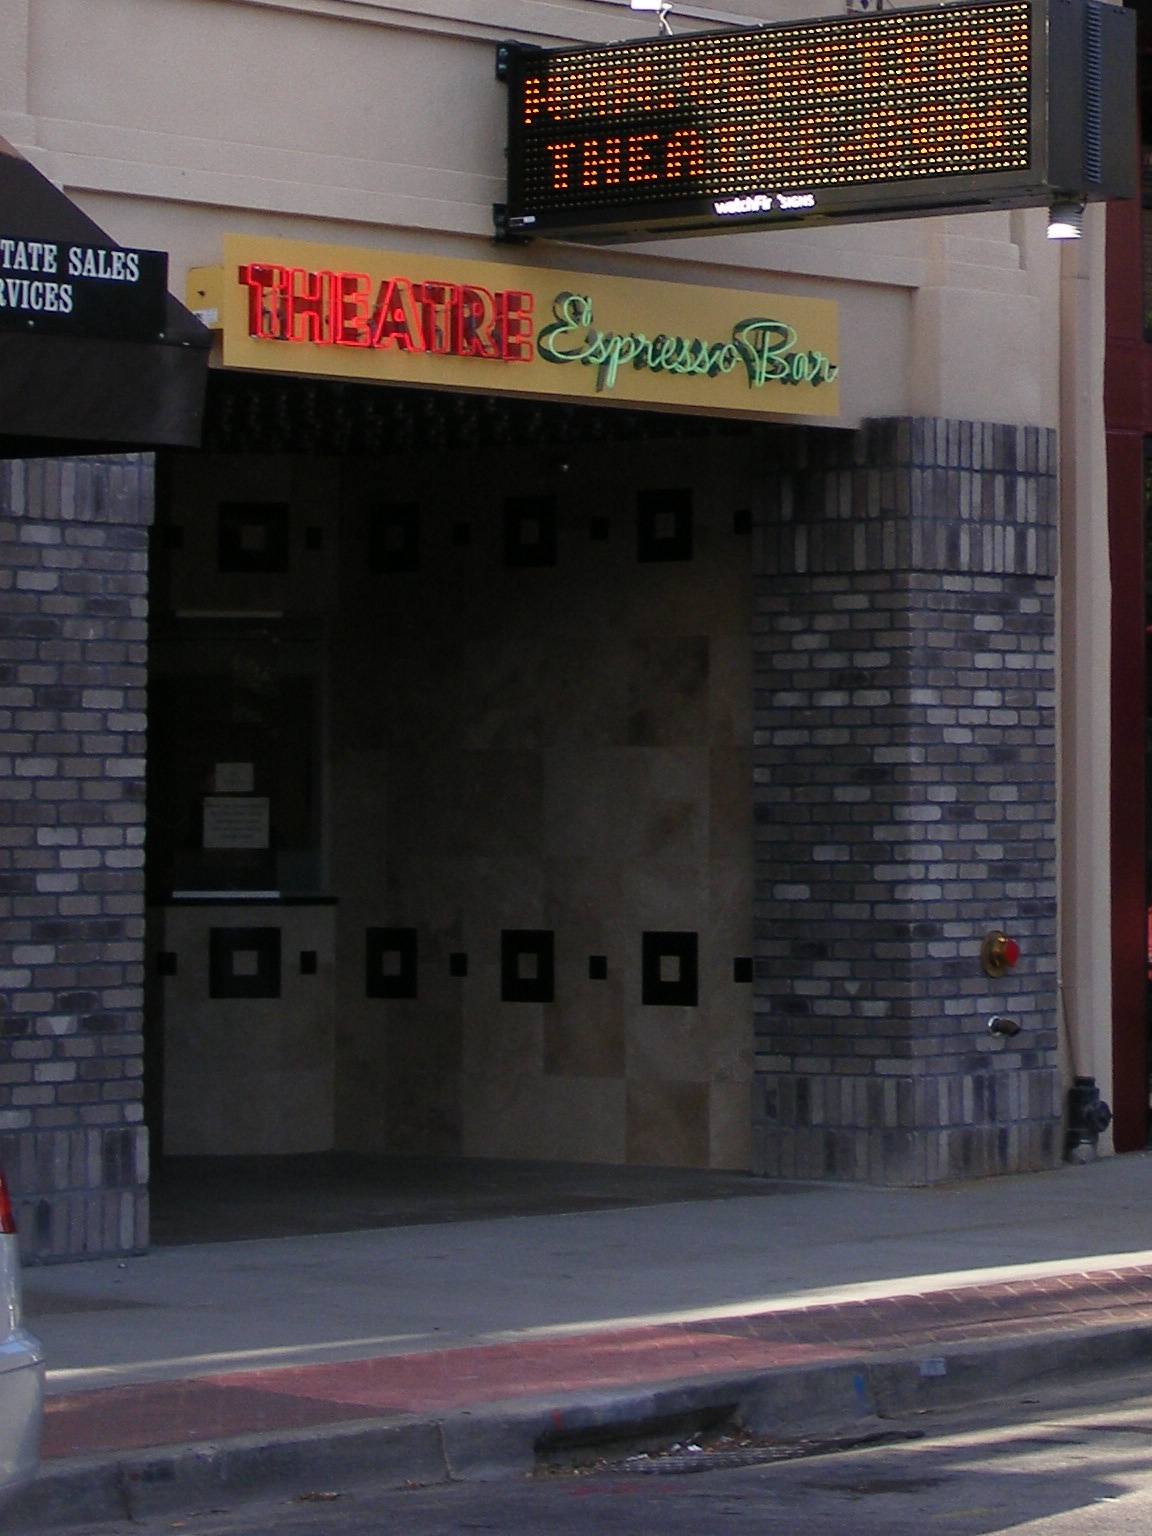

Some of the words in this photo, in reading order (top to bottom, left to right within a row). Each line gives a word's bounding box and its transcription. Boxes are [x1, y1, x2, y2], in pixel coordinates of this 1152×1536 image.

[69, 247, 140, 282] SALES
[238, 263, 534, 363] THEATRE
[539, 292, 741, 390] Espresso
[733, 316, 840, 389] Bar
